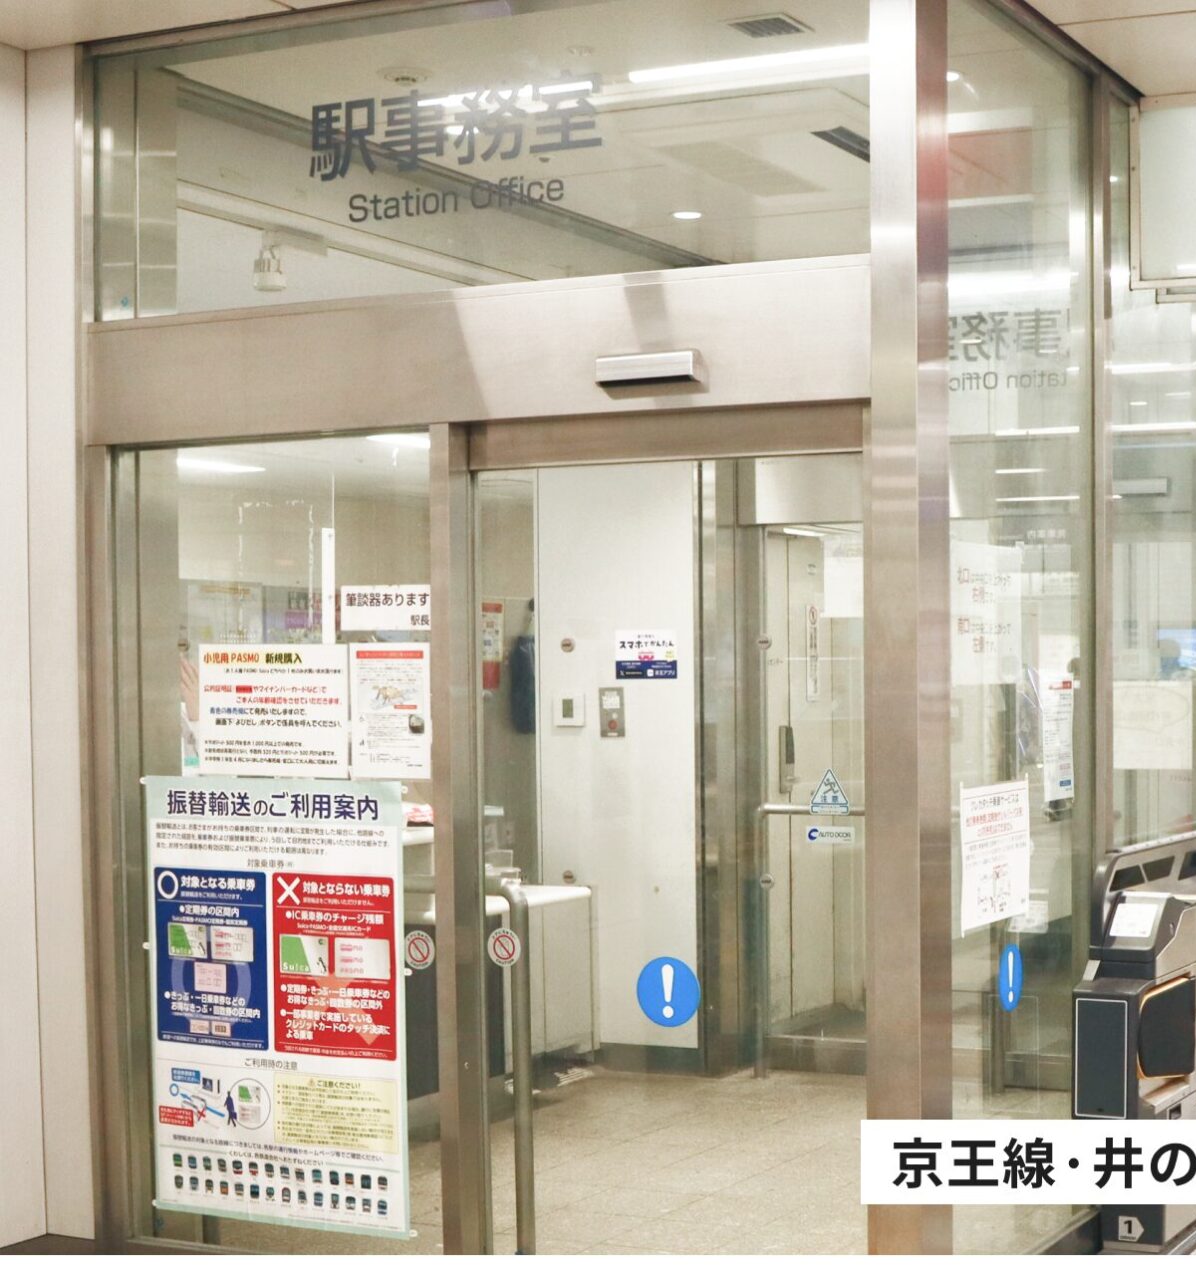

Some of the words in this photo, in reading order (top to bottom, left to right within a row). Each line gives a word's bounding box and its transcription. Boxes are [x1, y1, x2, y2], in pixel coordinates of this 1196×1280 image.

[309, 70, 604, 182] 駅事務室
[348, 190, 460, 223] Station
[470, 176, 566, 210] Office
[346, 592, 430, 607] 筆談器あります
[410, 614, 429, 626] 駅長
[204, 653, 229, 664] 小児用
[231, 653, 260, 664] PASMO
[265, 652, 303, 664] 新規購入
[167, 789, 379, 821] 振替輸送のご利用案内
[180, 875, 256, 891] 対象となる乗車券
[302, 881, 391, 898] 対象とならない乗車券
[244, 1058, 298, 1071] ご利用時の注意
[1123, 1220, 1133, 1235] 1
